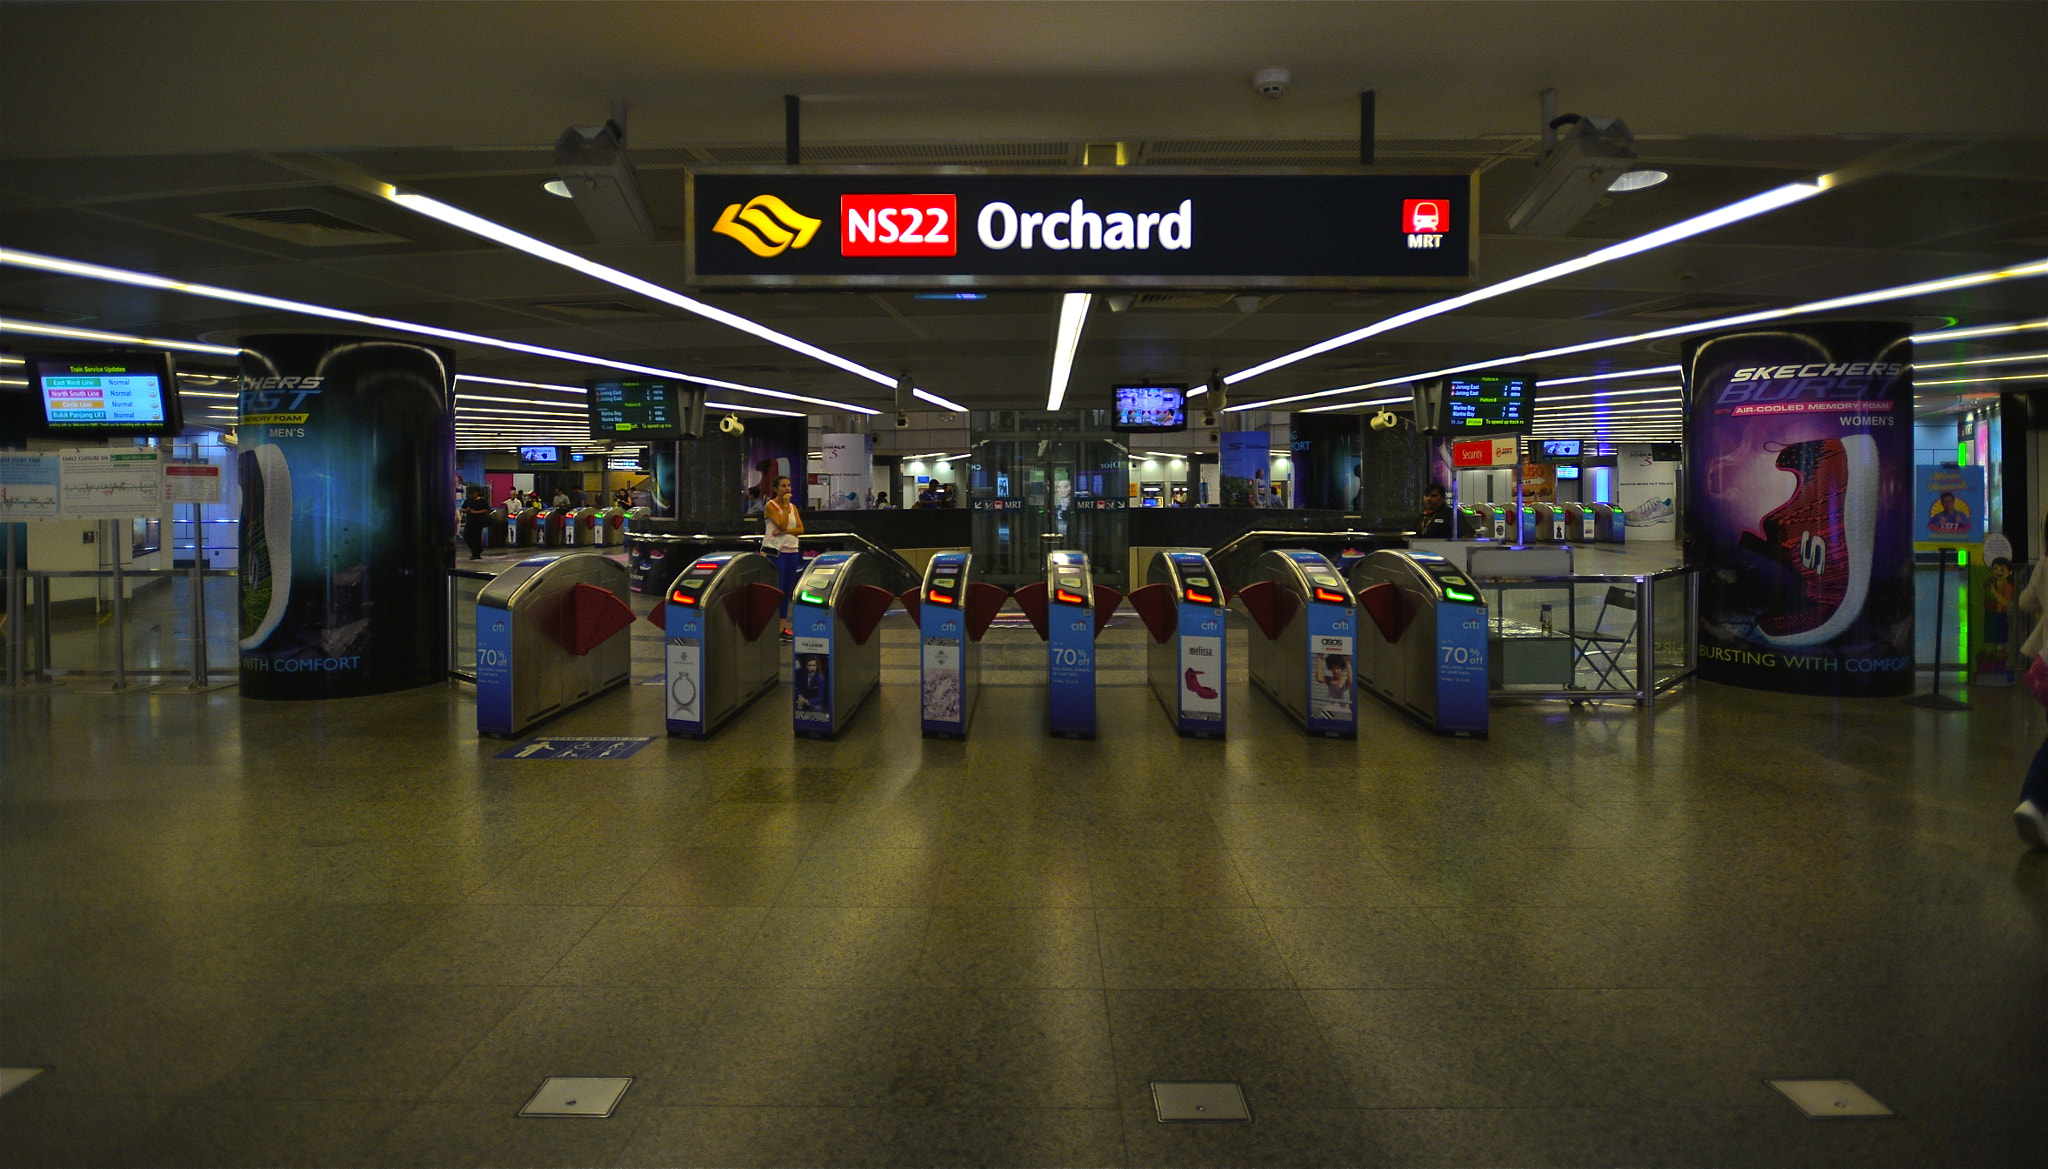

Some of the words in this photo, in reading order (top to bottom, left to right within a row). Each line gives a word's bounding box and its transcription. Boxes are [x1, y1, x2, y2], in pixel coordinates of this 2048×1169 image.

[847, 207, 949, 244] NS22
[977, 198, 1192, 250] Orchard
[1408, 234, 1443, 248] MRT
[1730, 363, 1902, 382] SKECHERS
[1716, 376, 1895, 404] BURST
[1735, 404, 1805, 414] AIR-COOLED
[1808, 402, 1860, 410] MEMORY
[1840, 416, 1894, 426] WOMEN'S
[269, 428, 305, 438] MEN'S
[1462, 448, 1483, 460] Security
[1004, 501, 1022, 509] MRT
[1077, 501, 1095, 509] MRT
[492, 623, 505, 632] citi
[941, 623, 956, 632] citi
[1071, 622, 1087, 632] citi
[1201, 621, 1218, 631] citi
[1332, 621, 1349, 631] citi
[1462, 620, 1480, 630] citi
[1321, 638, 1343, 646] asos
[1469, 656, 1483, 665] off
[1699, 644, 1776, 668] BURSTING
[274, 656, 361, 672] COMFORT
[497, 658, 507, 667] off
[1078, 657, 1090, 666] off
[1783, 655, 1837, 671] WITH
[1845, 655, 1911, 673] COMFORT
